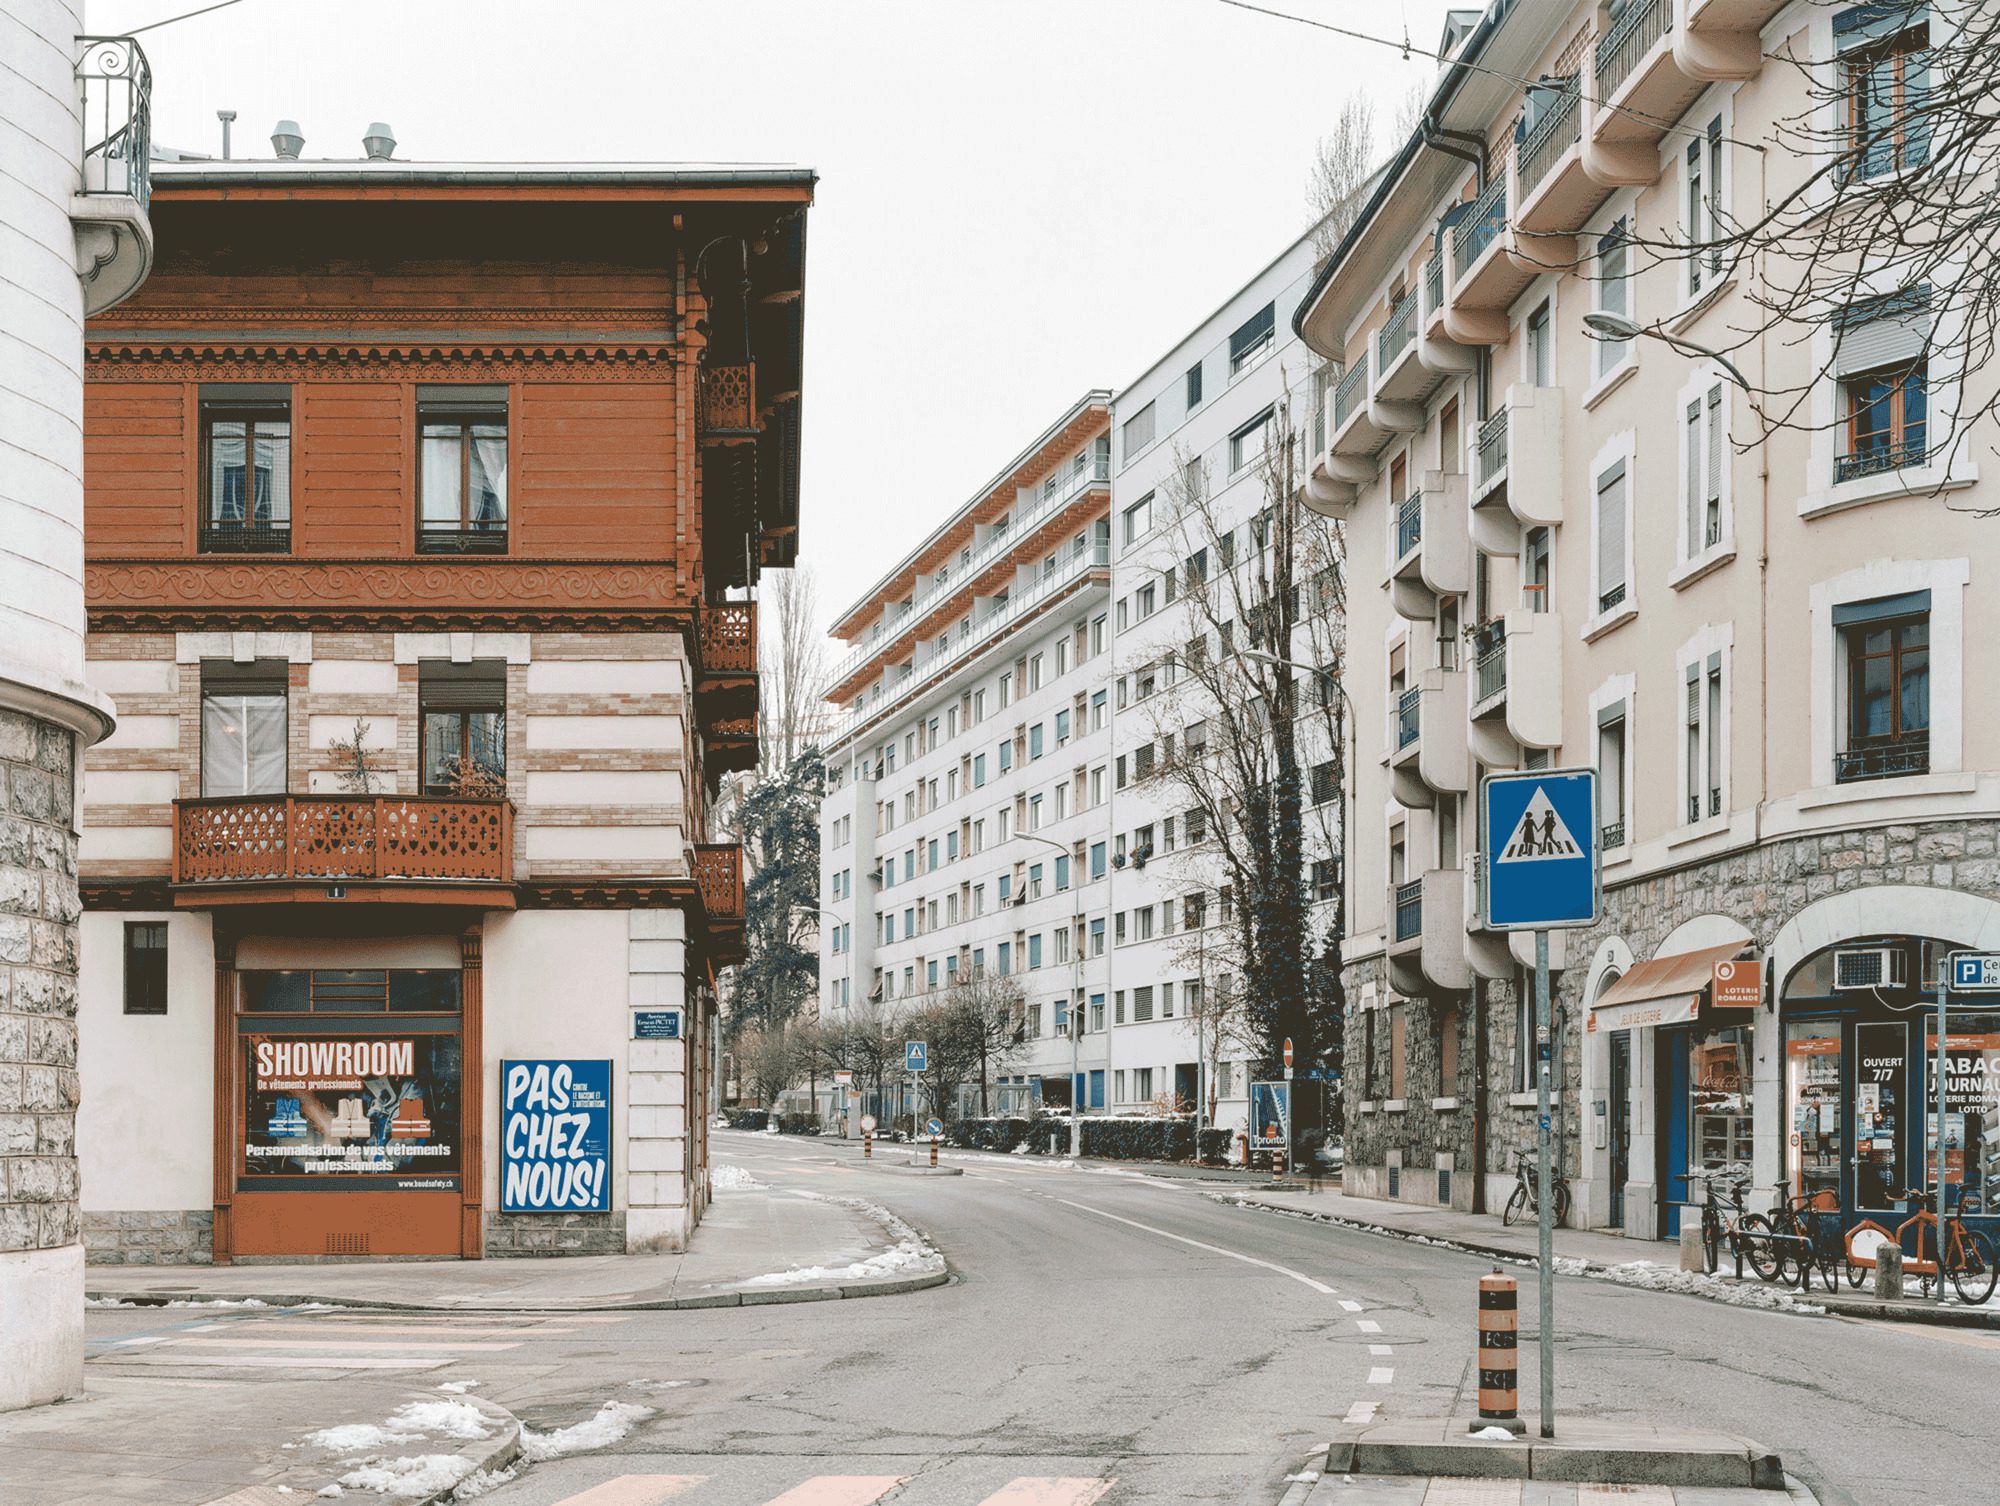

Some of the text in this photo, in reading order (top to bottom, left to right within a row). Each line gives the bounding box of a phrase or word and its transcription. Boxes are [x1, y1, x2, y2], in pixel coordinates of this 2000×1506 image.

[1983, 960, 2000, 970] Ce
[1963, 963, 1977, 982] P
[1983, 973, 1998, 984] de
[257, 1042, 413, 1077] SHOWROOM
[1863, 1057, 1903, 1067] OUVERT
[1872, 1069, 1894, 1081] 7/7
[257, 1078, 362, 1091] De vêtements professionnels
[506, 1063, 573, 1111] PAS
[1958, 1105, 1988, 1113] LOTTO
[505, 1112, 591, 1160] CHEZ
[1253, 1134, 1285, 1145] Toronto
[246, 1144, 451, 1156] Personnalisation de vos vêtements
[305, 1159, 394, 1173] professionnels
[505, 1157, 606, 1209] NOUS!
